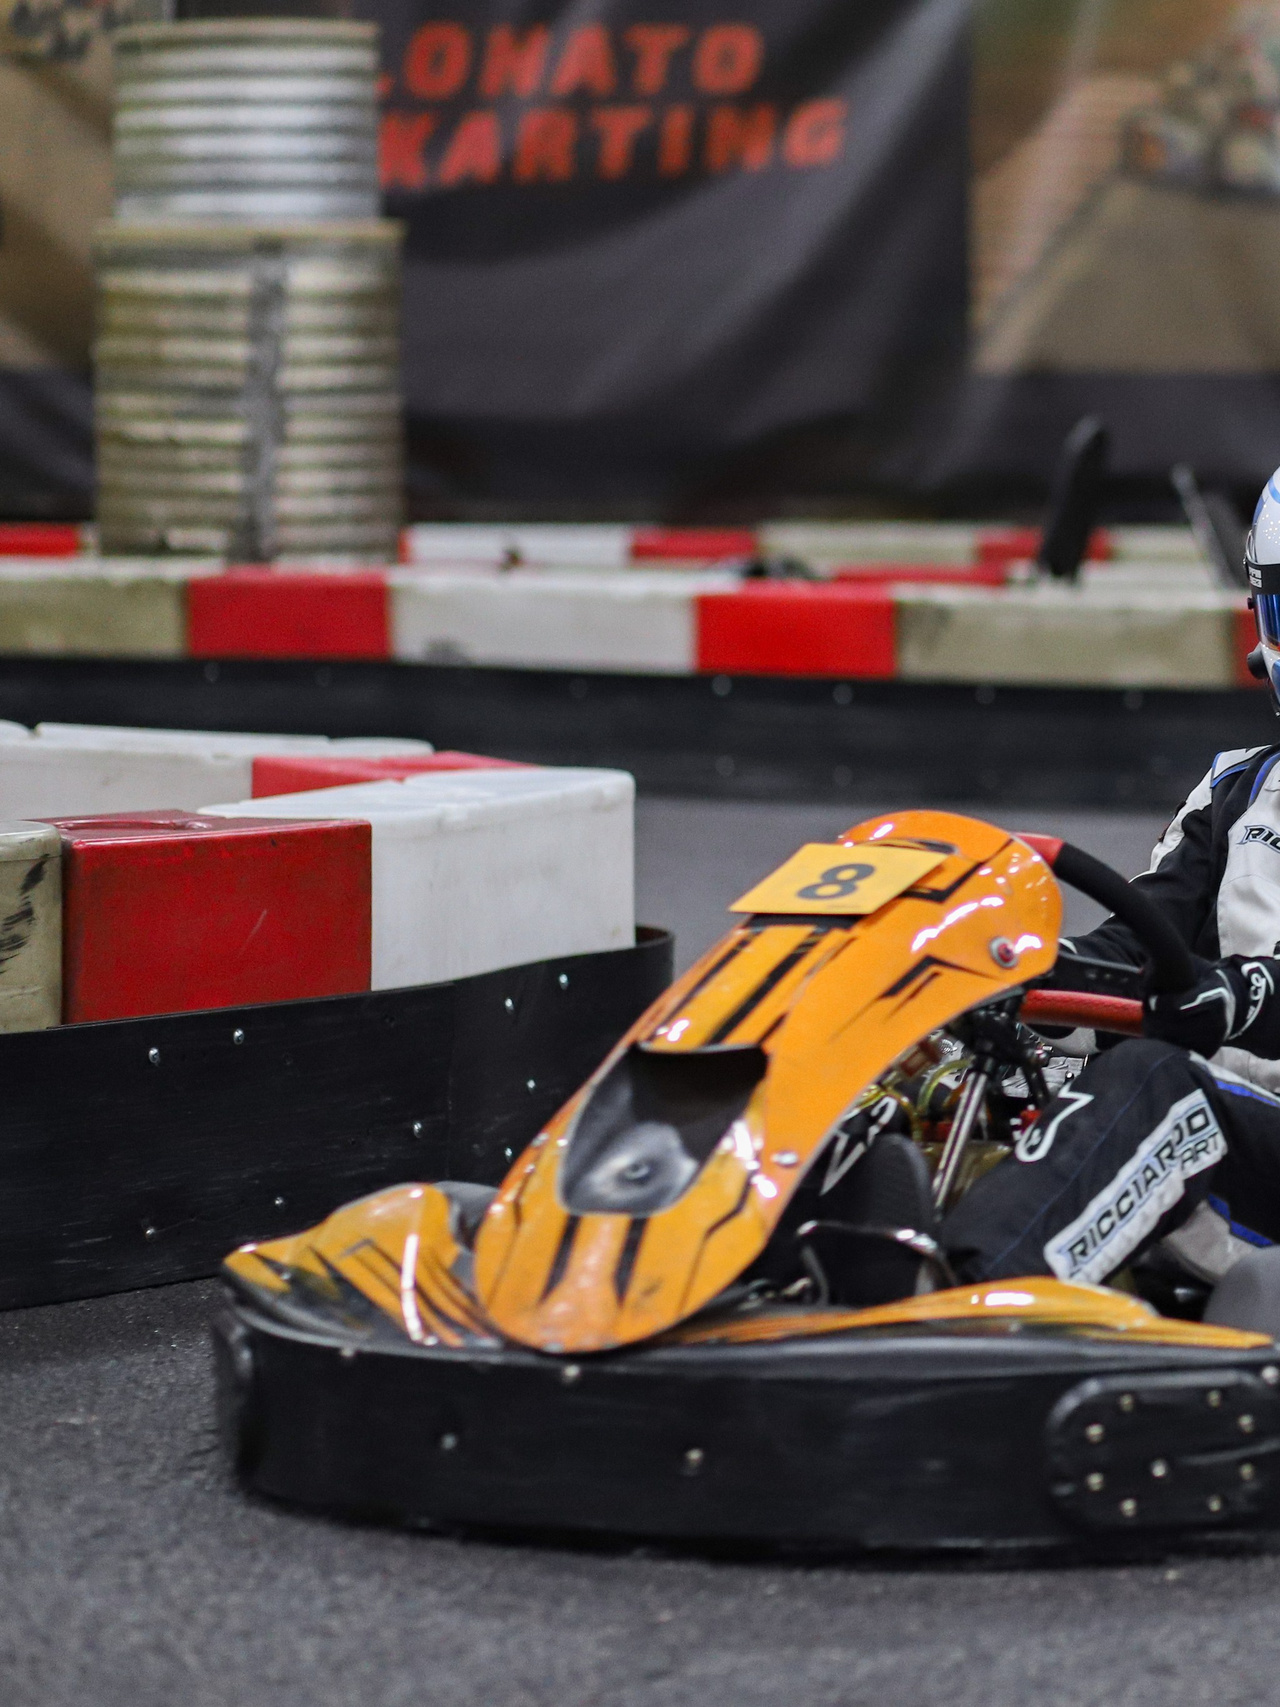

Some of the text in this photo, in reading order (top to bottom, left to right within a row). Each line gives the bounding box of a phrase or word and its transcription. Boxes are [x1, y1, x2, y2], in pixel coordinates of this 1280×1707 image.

[376, 20, 764, 97] ONATO
[376, 97, 847, 190] KARTING
[797, 863, 876, 900] 8
[1180, 1131, 1220, 1171] ART
